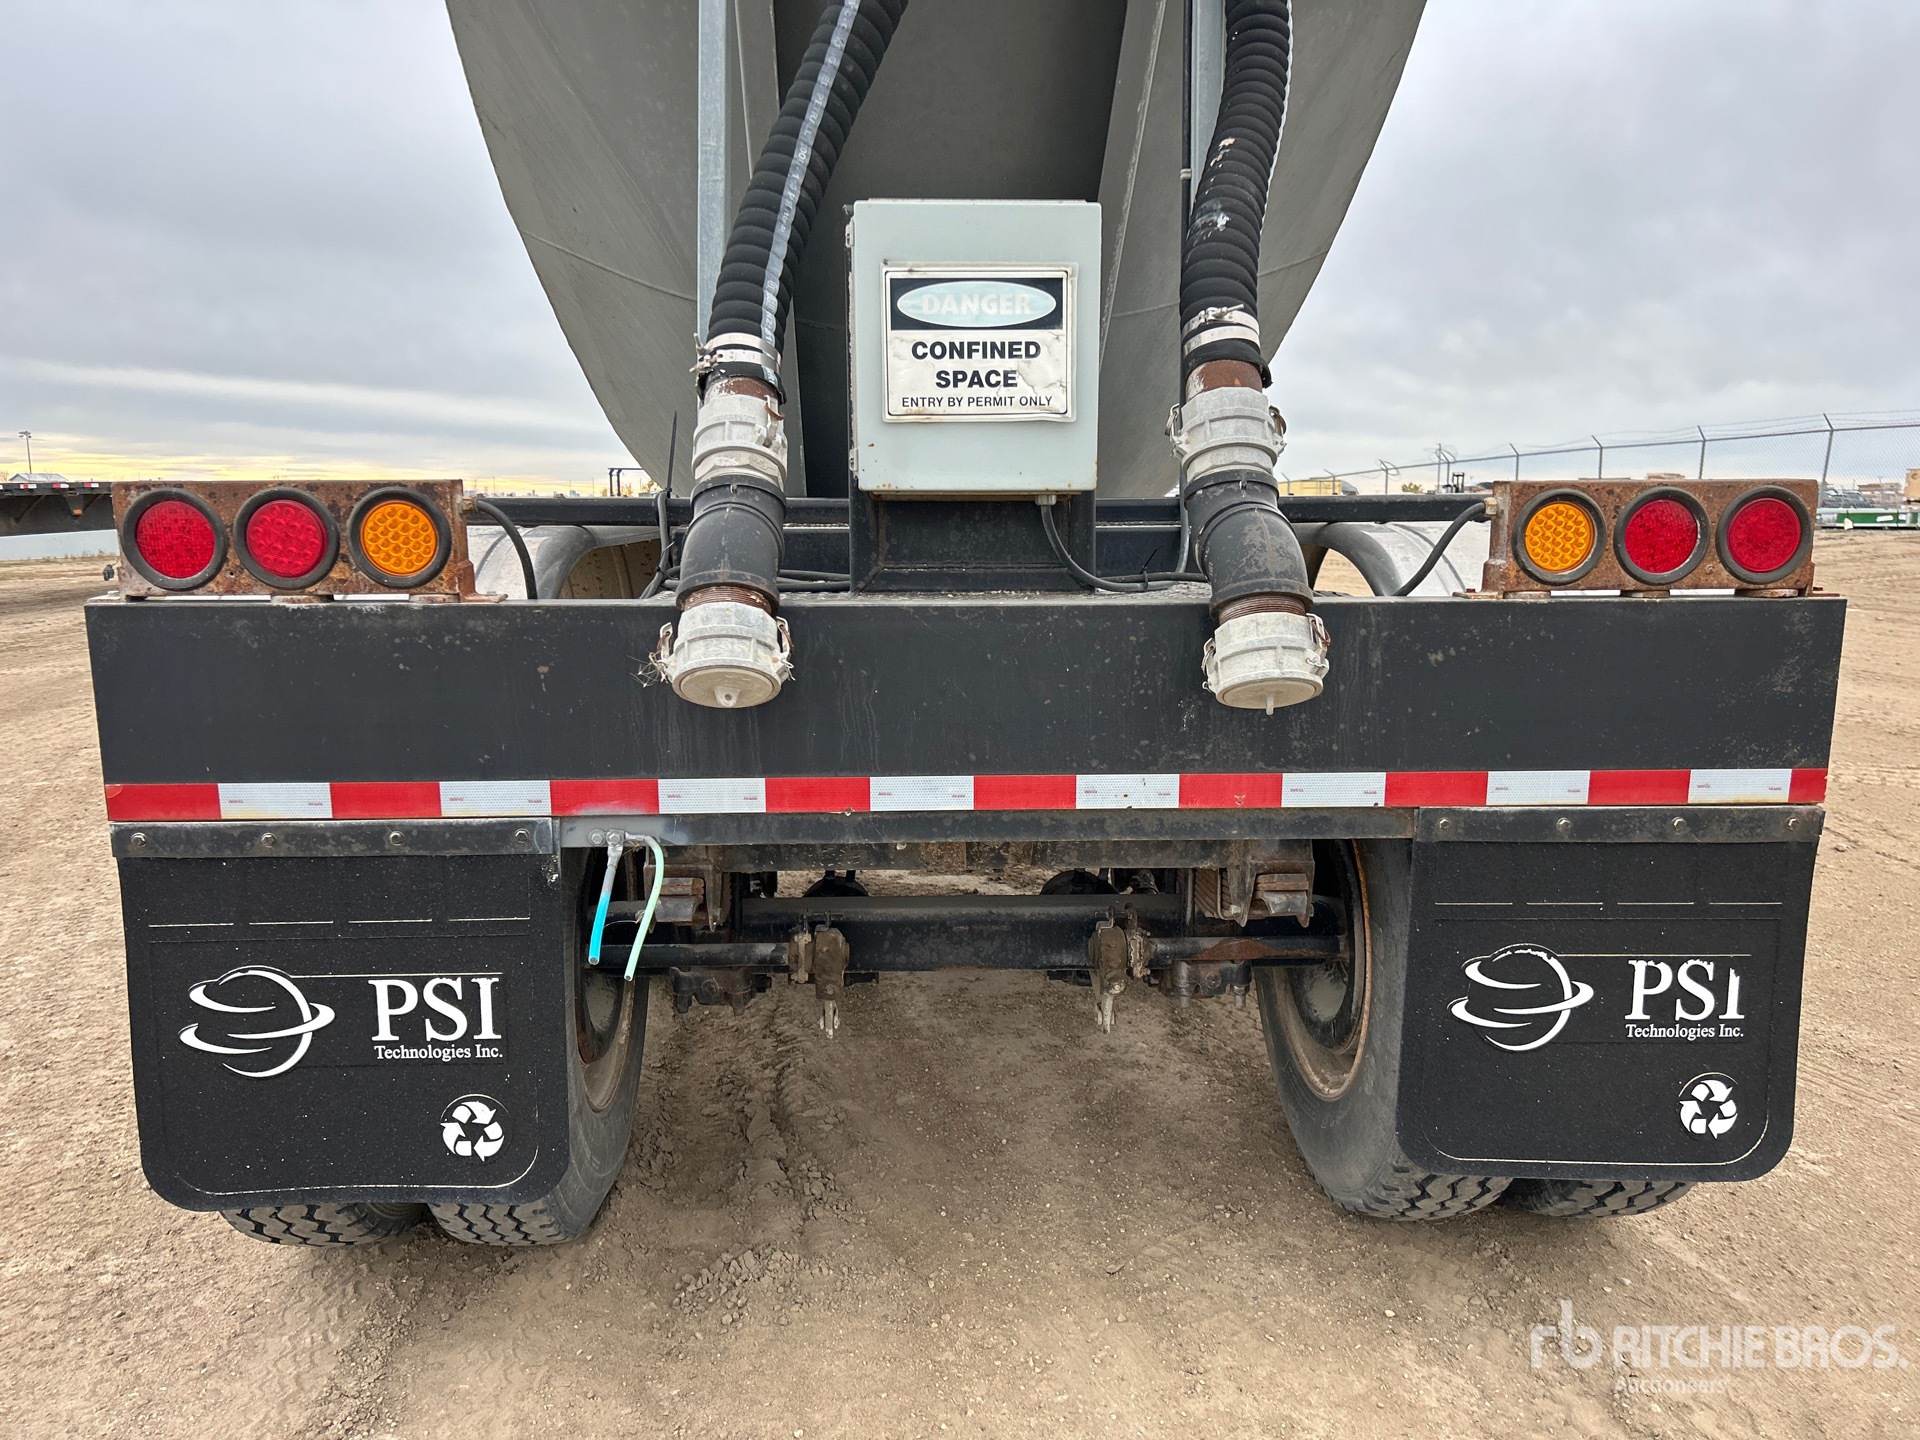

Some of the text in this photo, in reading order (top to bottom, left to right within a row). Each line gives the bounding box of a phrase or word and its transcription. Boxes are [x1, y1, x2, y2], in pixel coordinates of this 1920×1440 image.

[921, 294, 1032, 316] DANGER
[911, 341, 1042, 360] CONFINED
[935, 370, 1019, 388] SPACE
[902, 395, 1053, 408] ENTRY BY PERMIT ONLY
[1624, 959, 1745, 1022] PSI
[367, 976, 502, 1042] PSI
[1625, 1023, 1745, 1042] Technologies Inc.
[373, 1044, 503, 1062] Technologies Inc.
